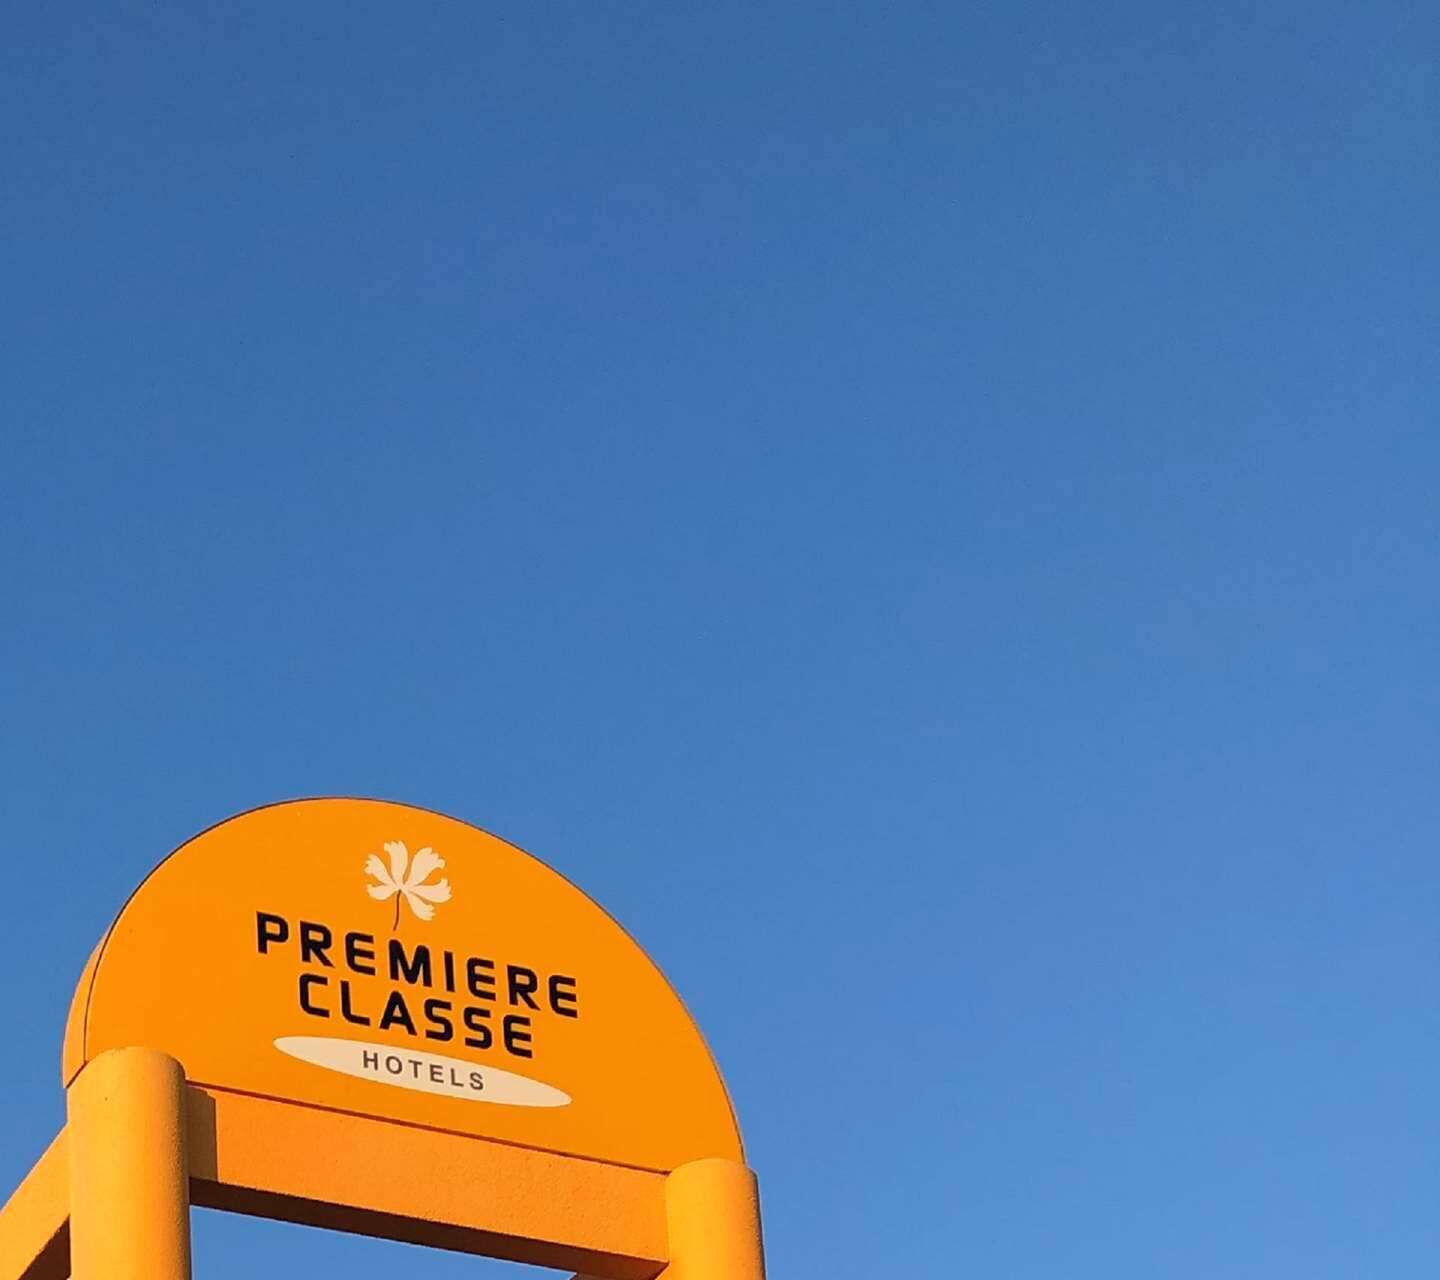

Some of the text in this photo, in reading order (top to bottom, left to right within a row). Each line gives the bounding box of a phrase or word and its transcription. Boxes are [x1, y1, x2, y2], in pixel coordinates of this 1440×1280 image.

[256, 911, 578, 1018] PREMIERE
[299, 974, 533, 1058] CLASSE
[363, 1049, 486, 1091] HOTELS
